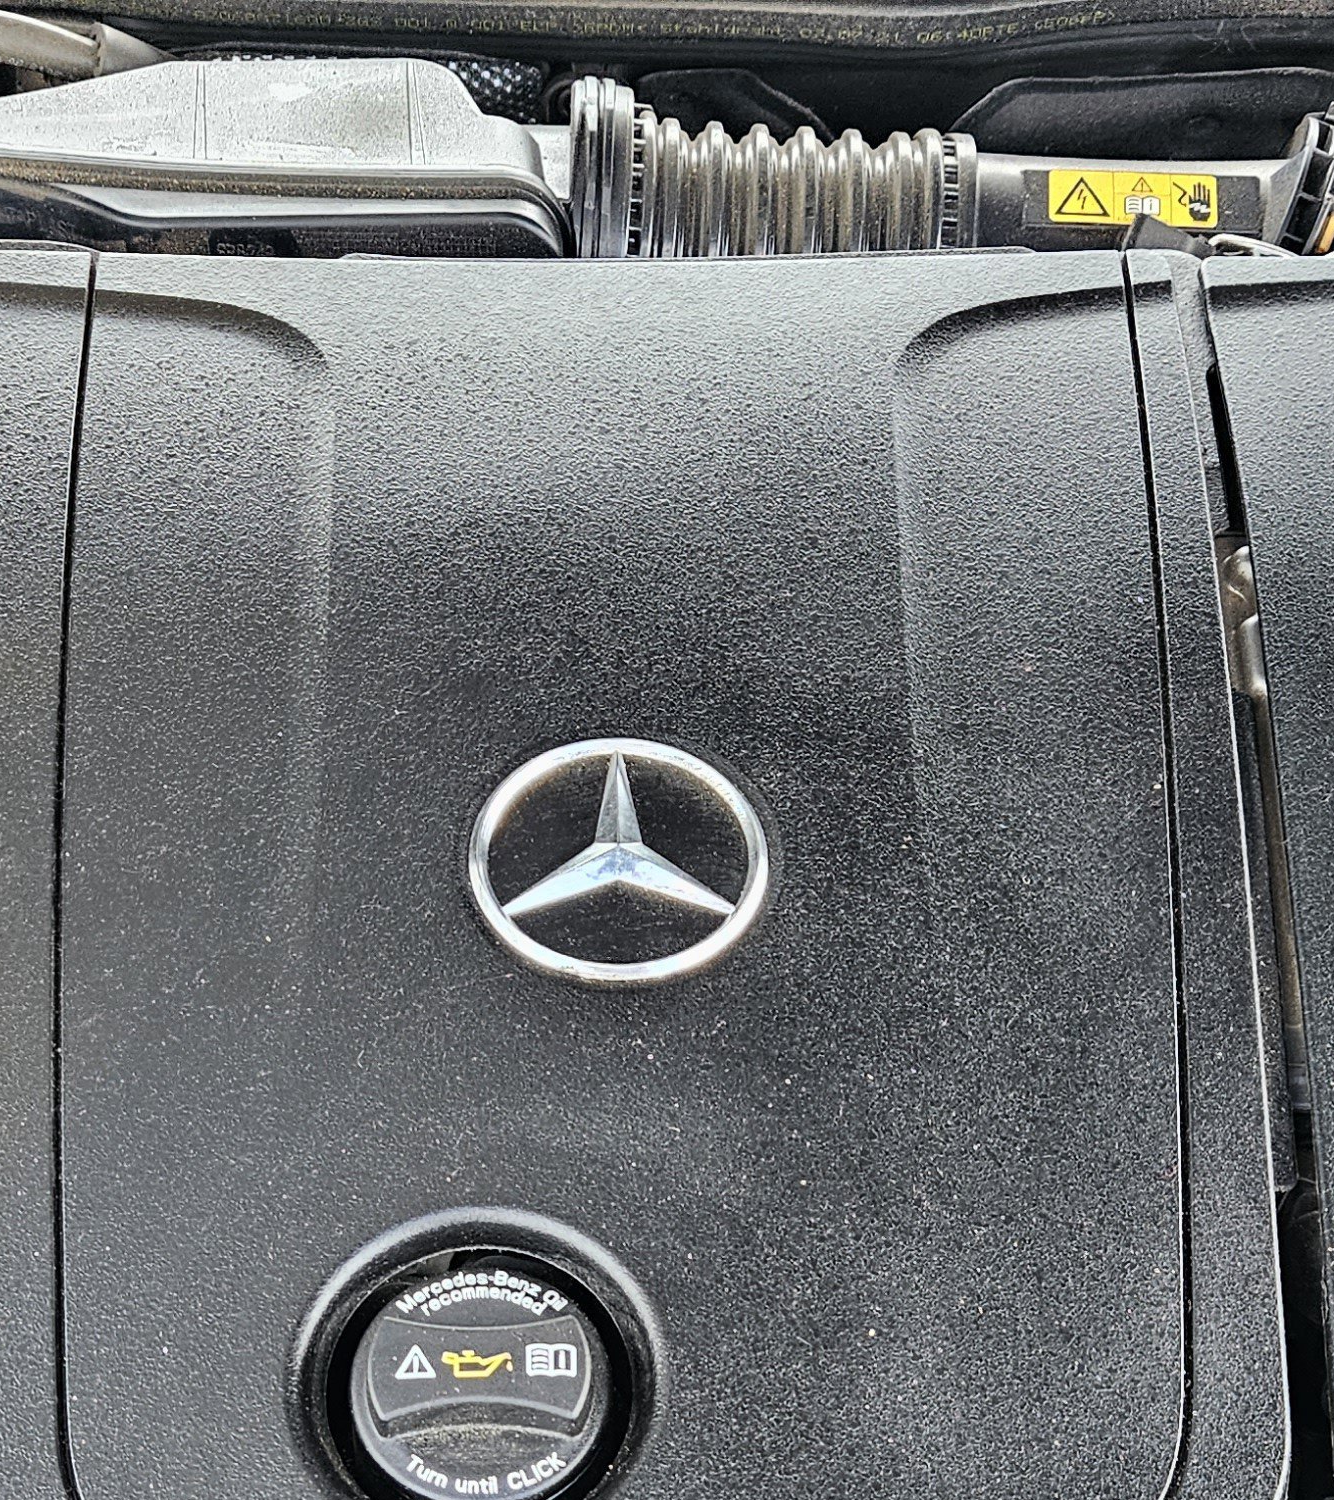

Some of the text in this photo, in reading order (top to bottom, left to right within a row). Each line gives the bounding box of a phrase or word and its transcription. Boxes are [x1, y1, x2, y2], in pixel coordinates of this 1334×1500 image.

[396, 1271, 569, 1314] Mercedes-Benz Oil
[419, 1285, 549, 1317] recommended
[406, 1451, 567, 1494] Turn until CLICK
